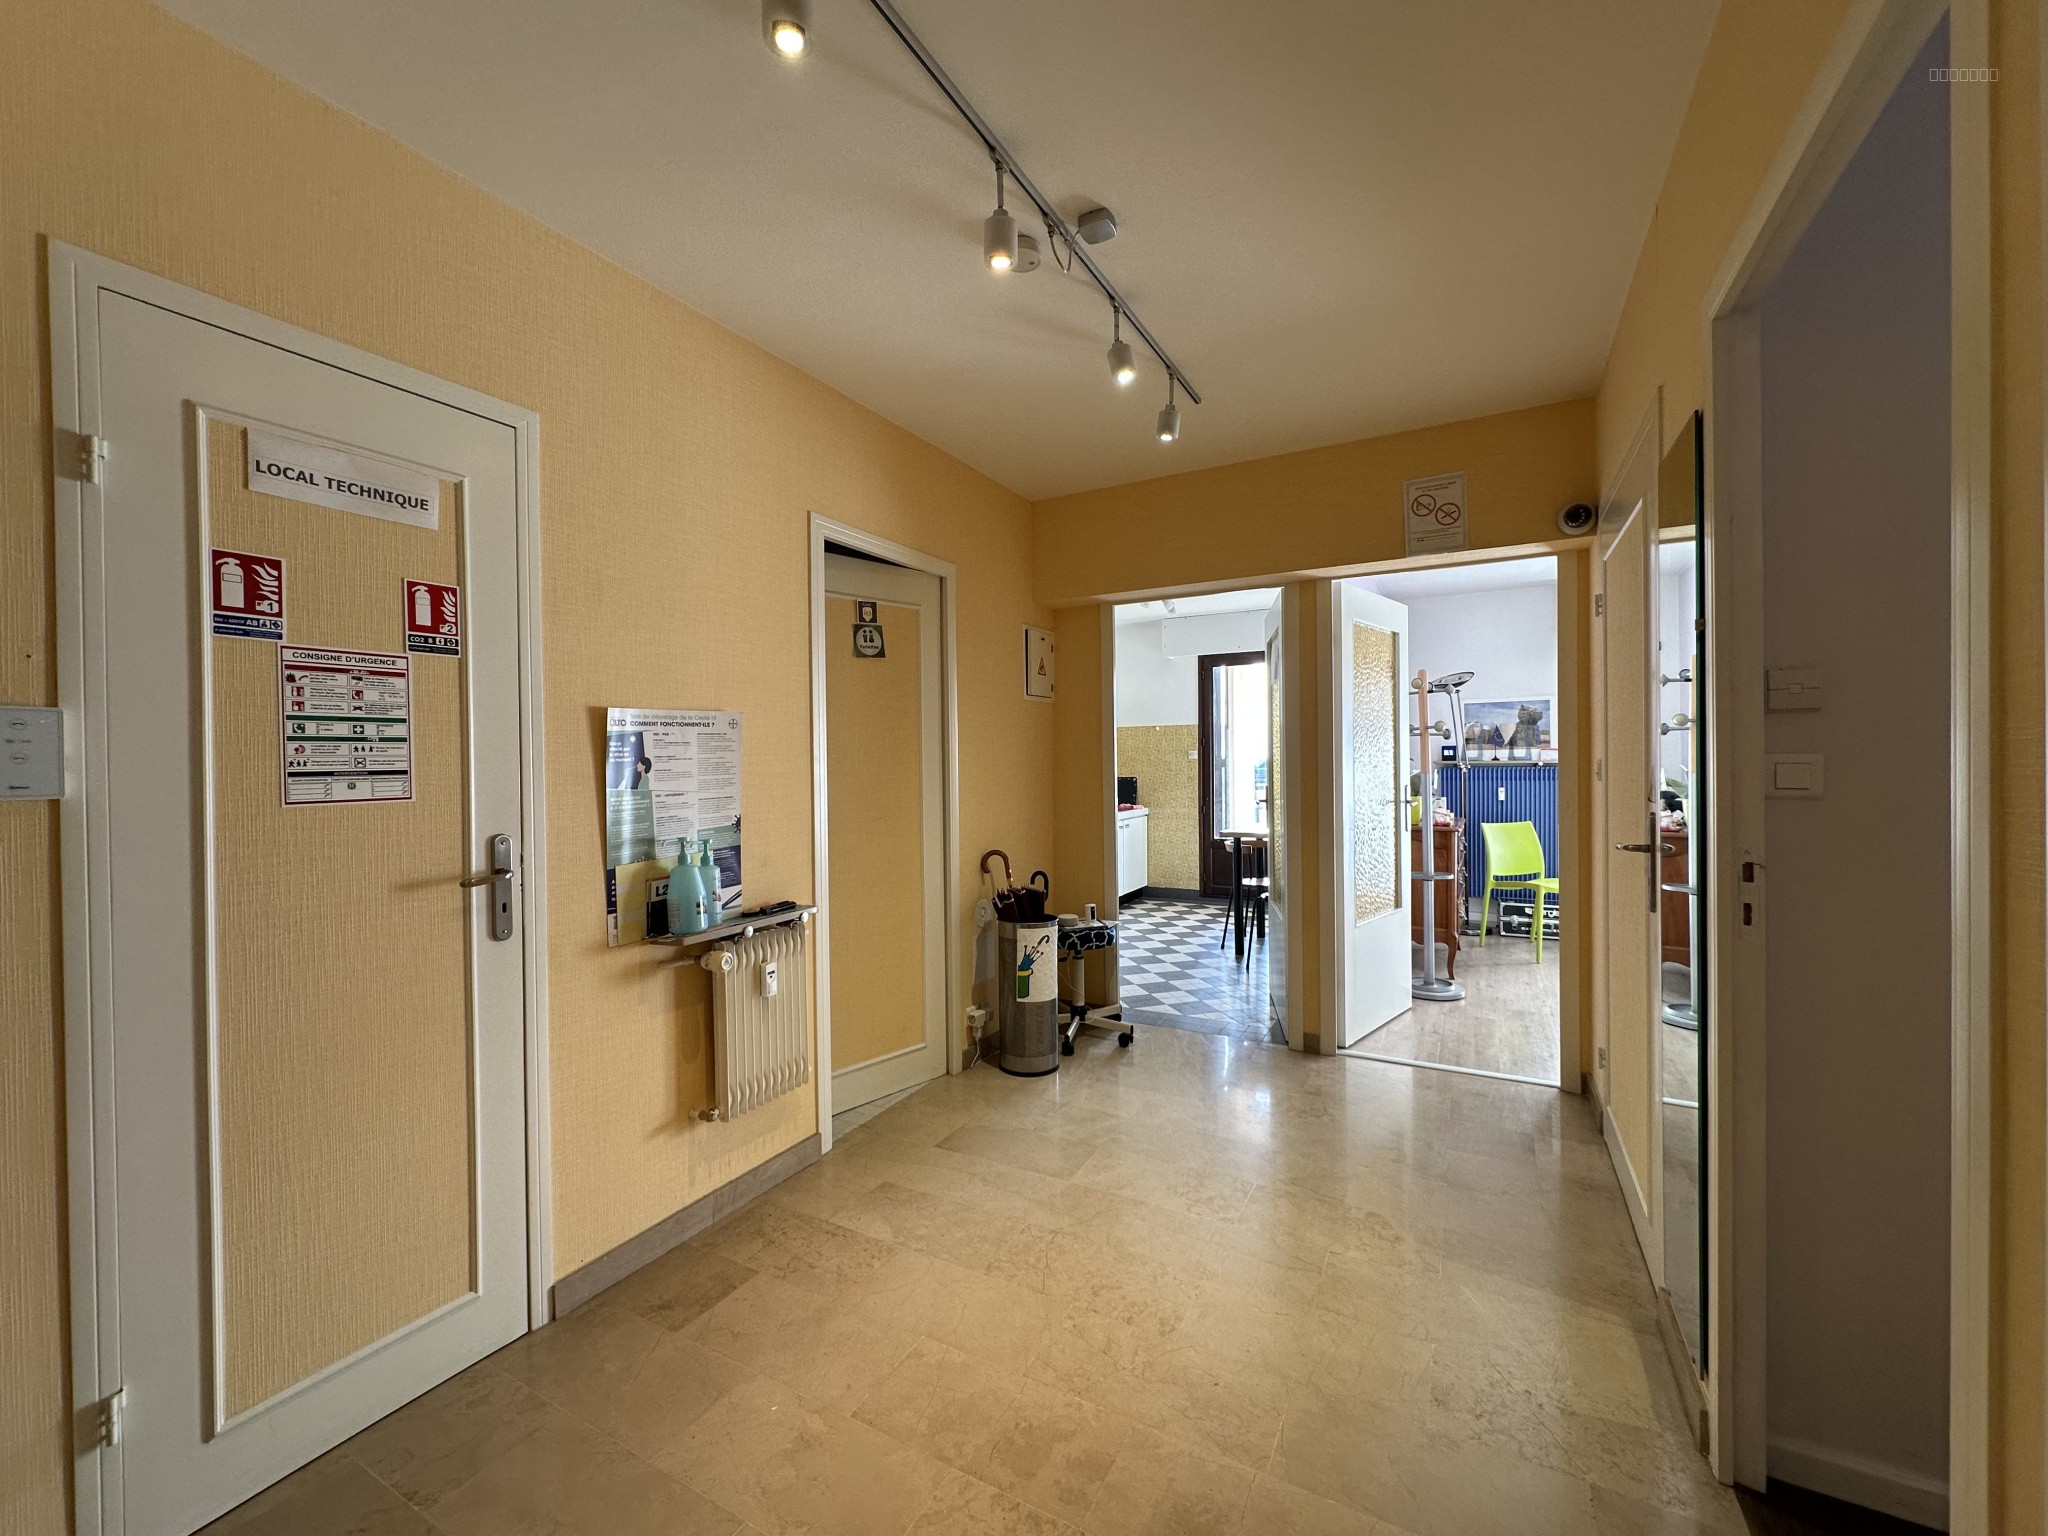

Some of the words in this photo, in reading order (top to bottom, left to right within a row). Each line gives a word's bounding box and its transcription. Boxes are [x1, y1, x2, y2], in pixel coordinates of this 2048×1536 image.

[255, 459, 319, 486] LOCAL
[324, 476, 429, 511] TECHNIQUE
[267, 602, 273, 612] 1
[446, 625, 453, 633] 2
[292, 651, 343, 662] CONSIGNE
[345, 656, 397, 667] D'URGENCE
